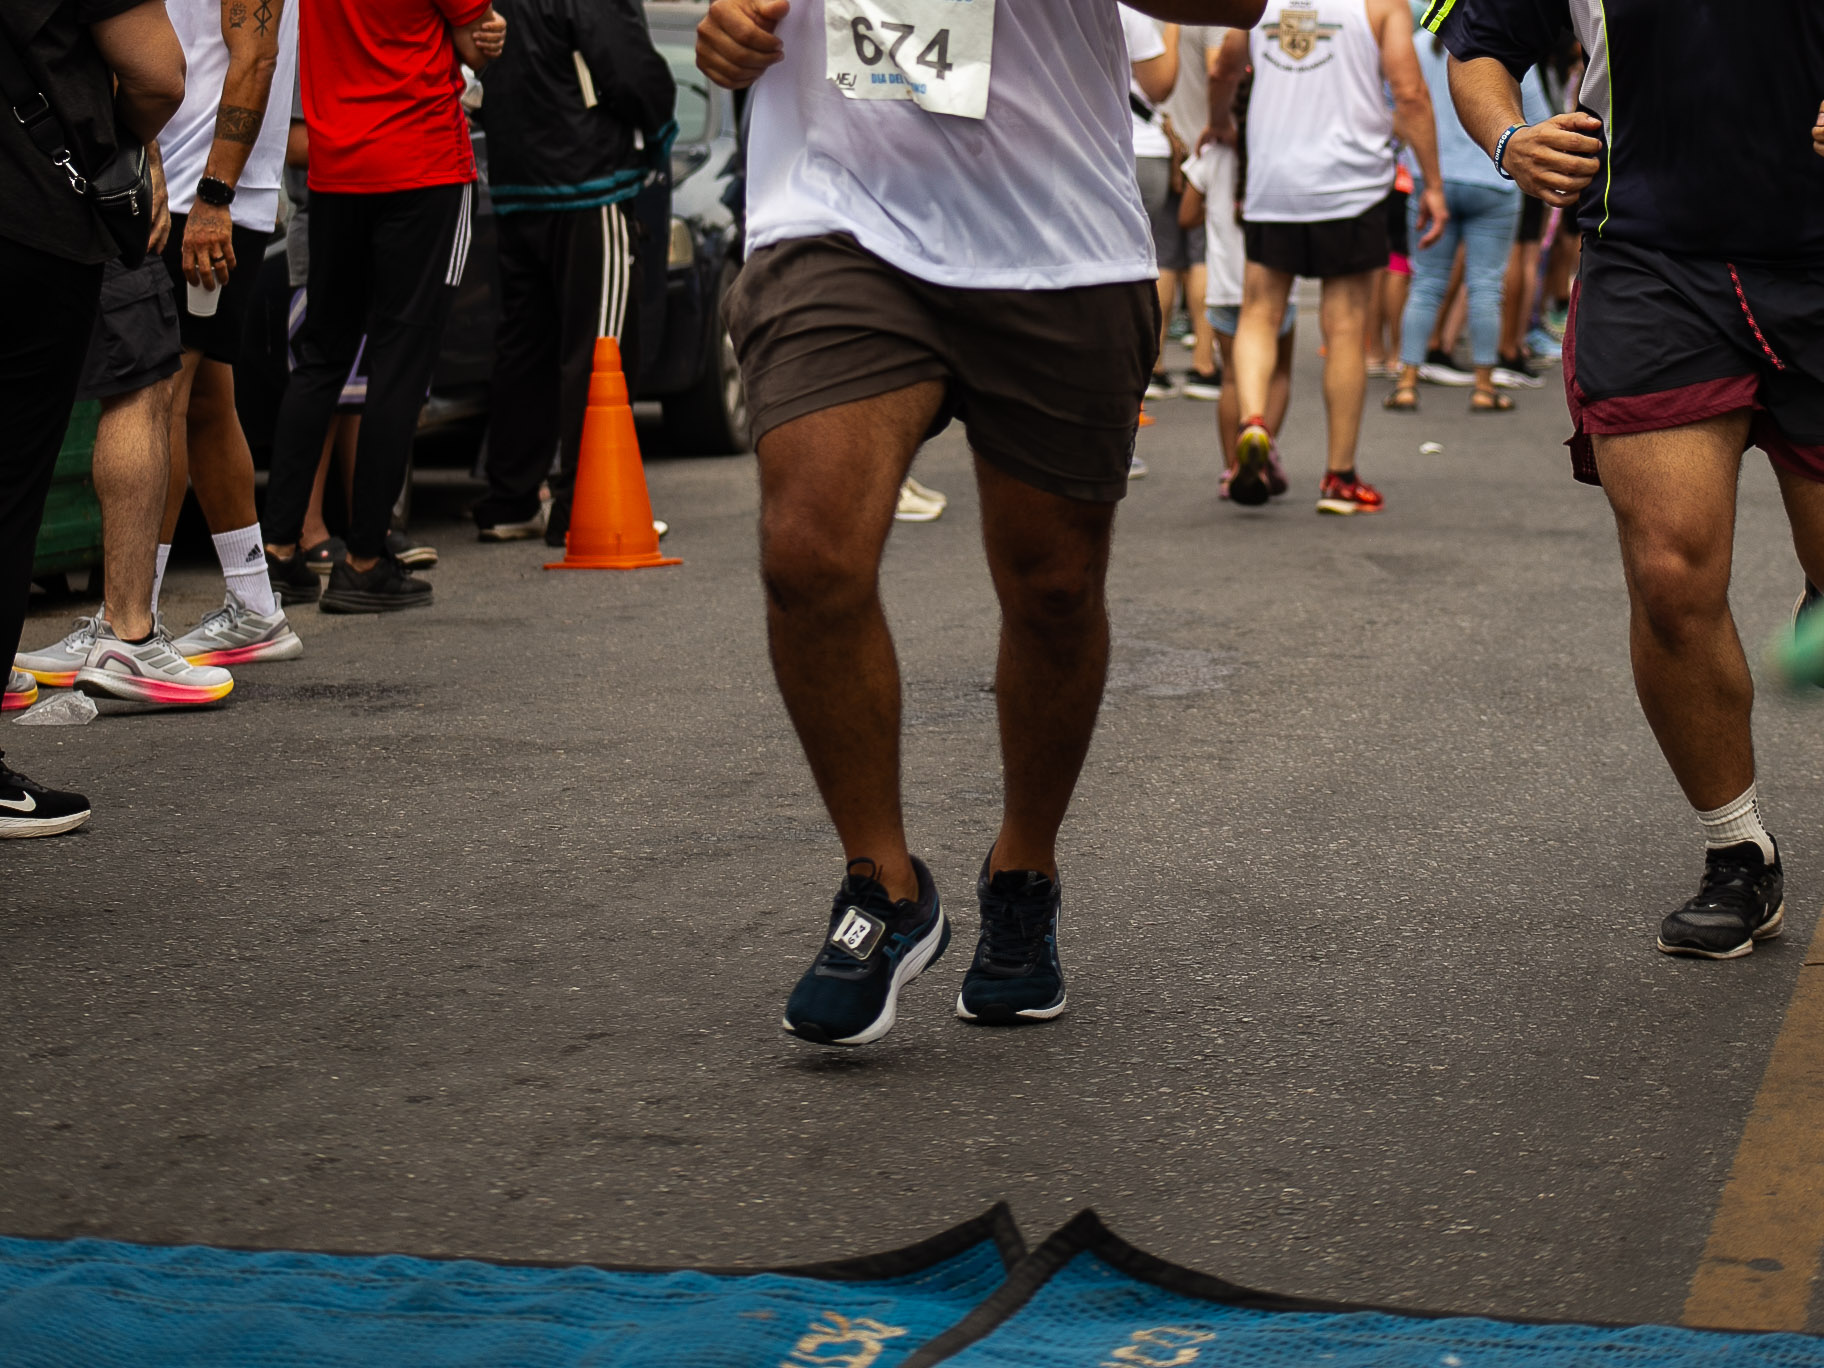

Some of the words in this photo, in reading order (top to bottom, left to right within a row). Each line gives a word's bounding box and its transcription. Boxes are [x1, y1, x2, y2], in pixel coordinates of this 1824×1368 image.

[851, 16, 953, 80] 674
[1494, 129, 1511, 161] ROSARIO
[847, 924, 866, 945] 674
